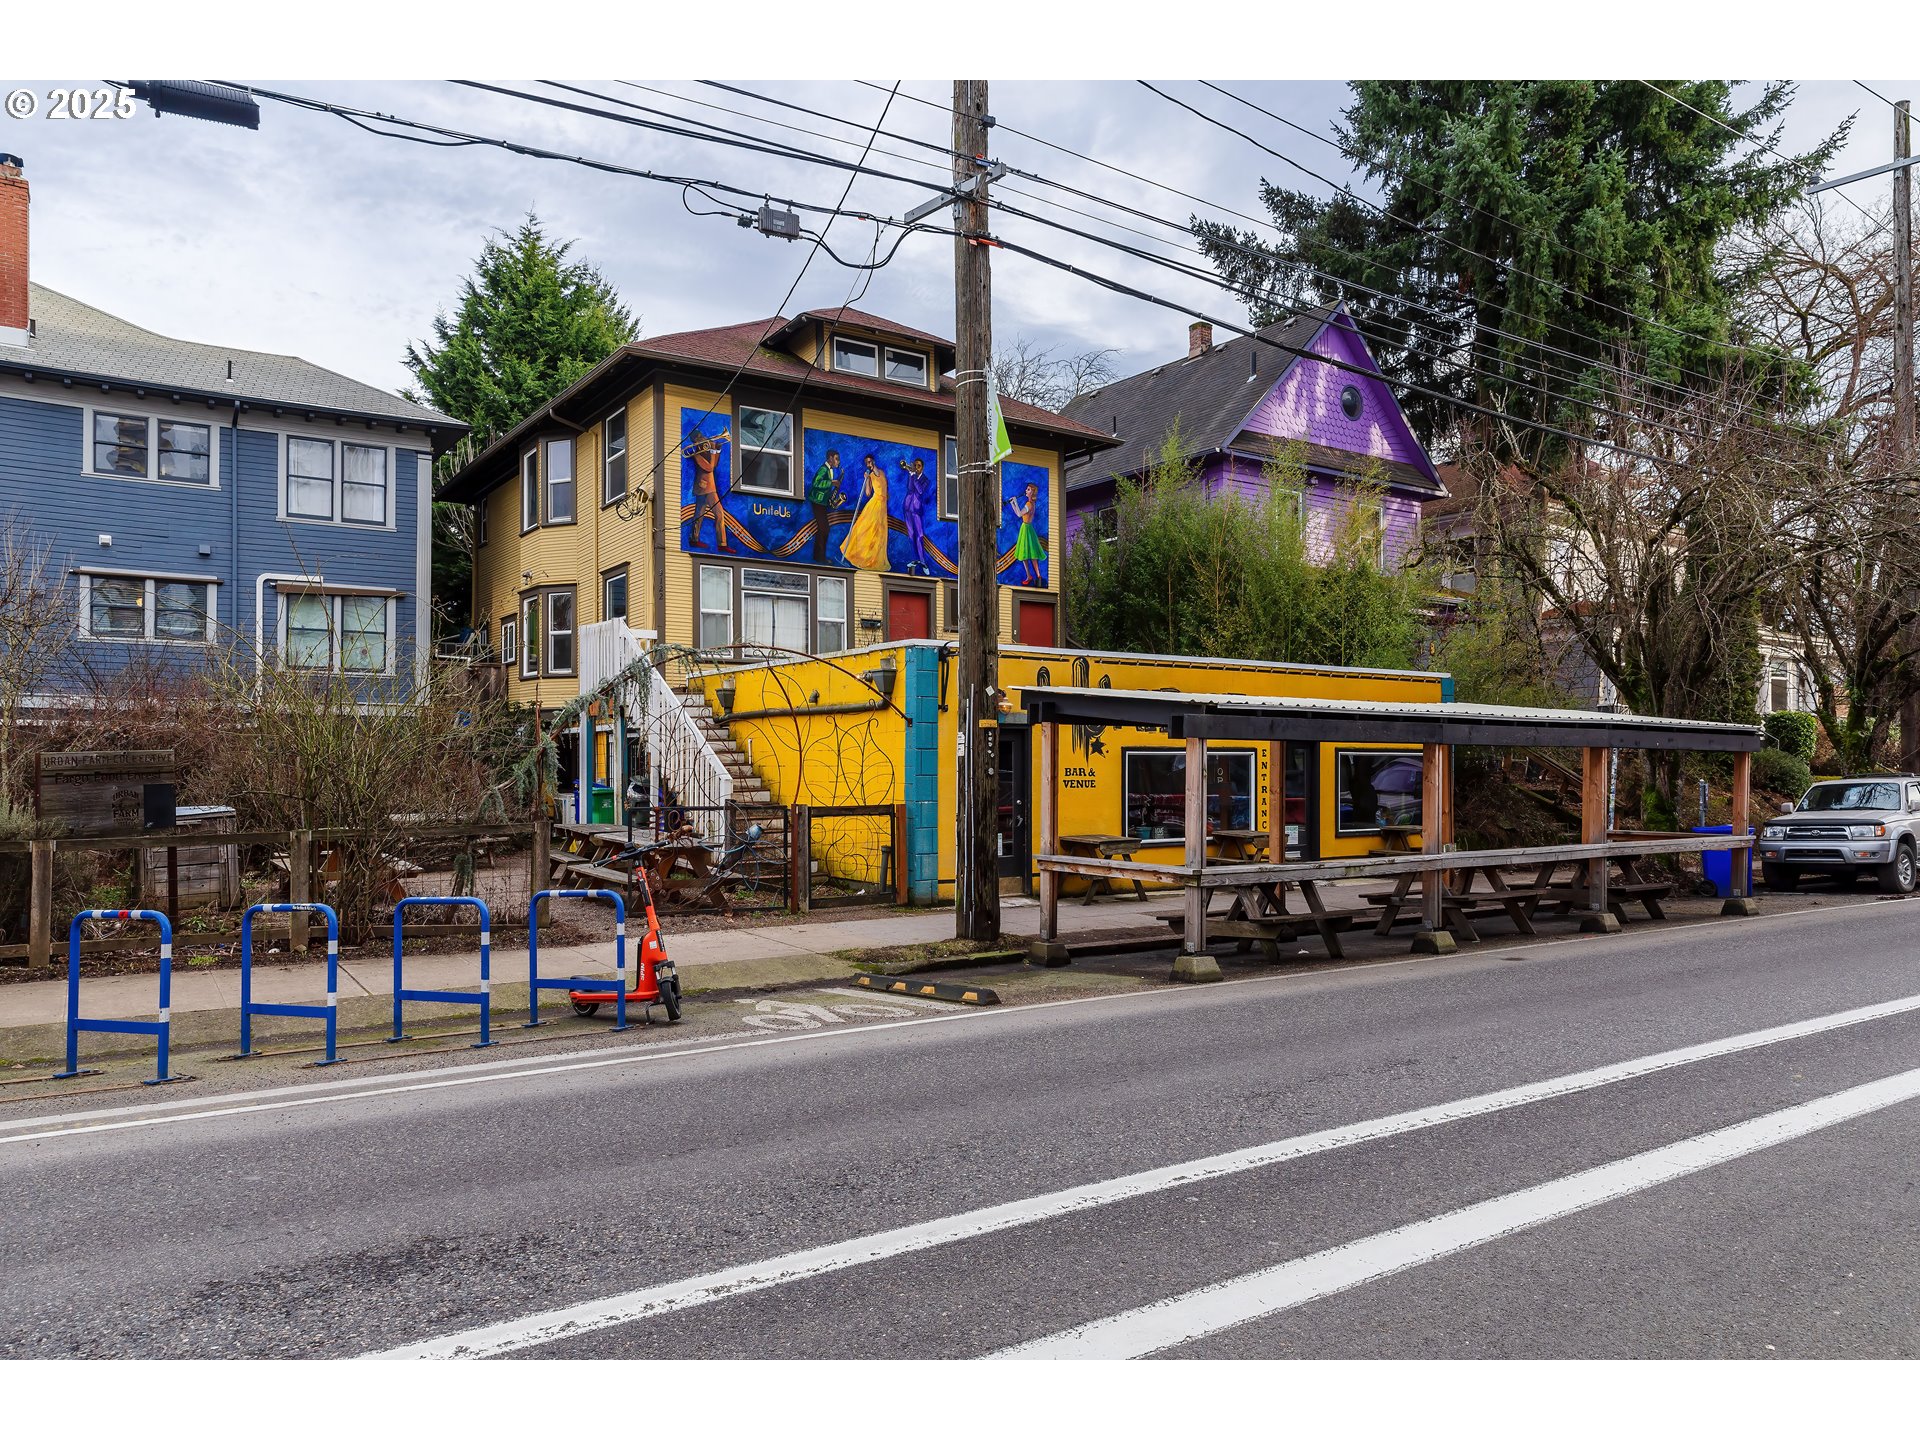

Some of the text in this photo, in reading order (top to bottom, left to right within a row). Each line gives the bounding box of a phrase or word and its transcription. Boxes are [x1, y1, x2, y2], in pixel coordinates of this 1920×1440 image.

[43, 756, 79, 767] URBAN
[82, 755, 109, 766] FARM
[1064, 768, 1096, 777] BAR &
[55, 772, 89, 786] Fargo
[1063, 780, 1096, 789] VENUE
[113, 789, 139, 801] URBAN
[113, 808, 139, 818] FARM
